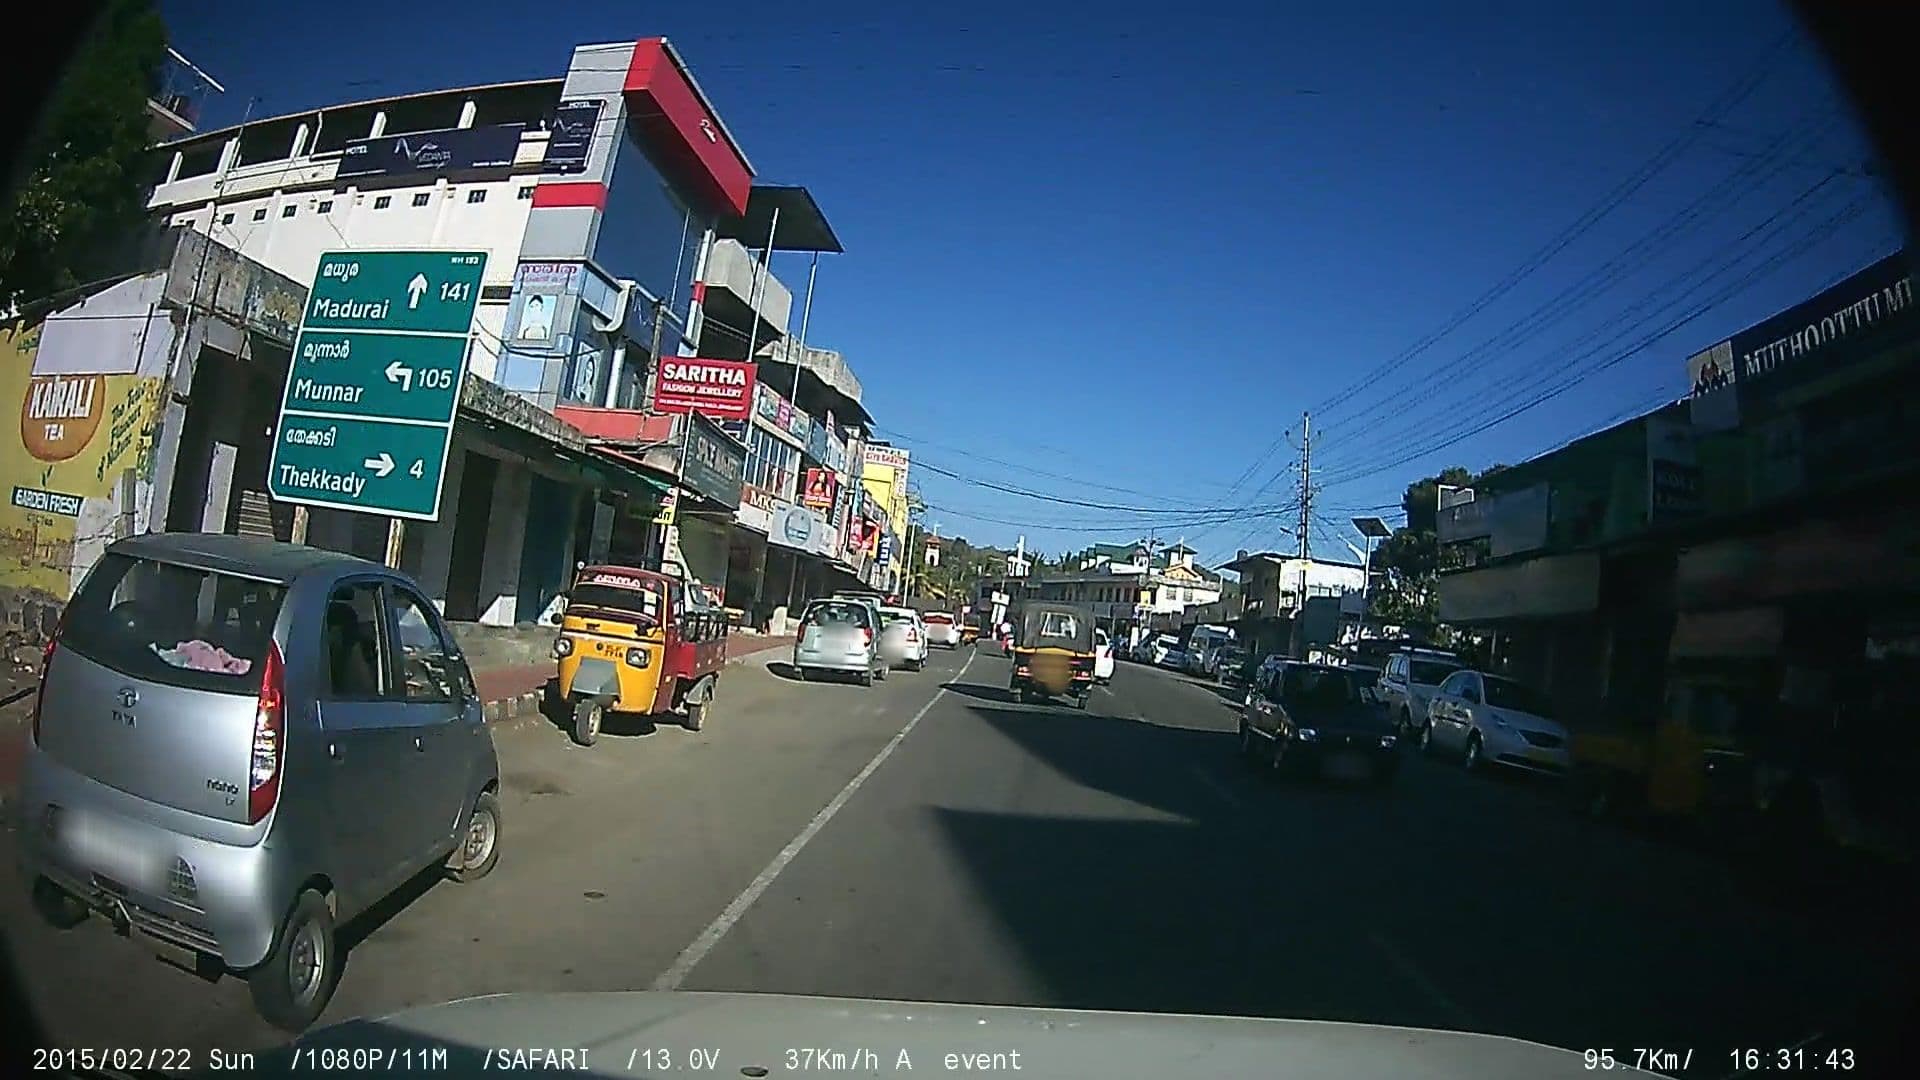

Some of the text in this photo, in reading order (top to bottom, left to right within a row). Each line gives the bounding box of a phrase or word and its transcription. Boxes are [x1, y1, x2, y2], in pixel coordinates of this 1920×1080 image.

[323, 262, 358, 282] മധുര
[313, 282, 470, 319] Madurai 141
[295, 368, 452, 403] Munnar 105
[663, 363, 746, 386] SARITHA
[29, 378, 96, 418] KAIRALI
[662, 382, 695, 393] FASHION
[44, 424, 64, 440] TEA
[280, 459, 424, 498] Thekkady 4
[16, 489, 79, 515] GARDEN FRESH
[112, 709, 137, 728] TATA
